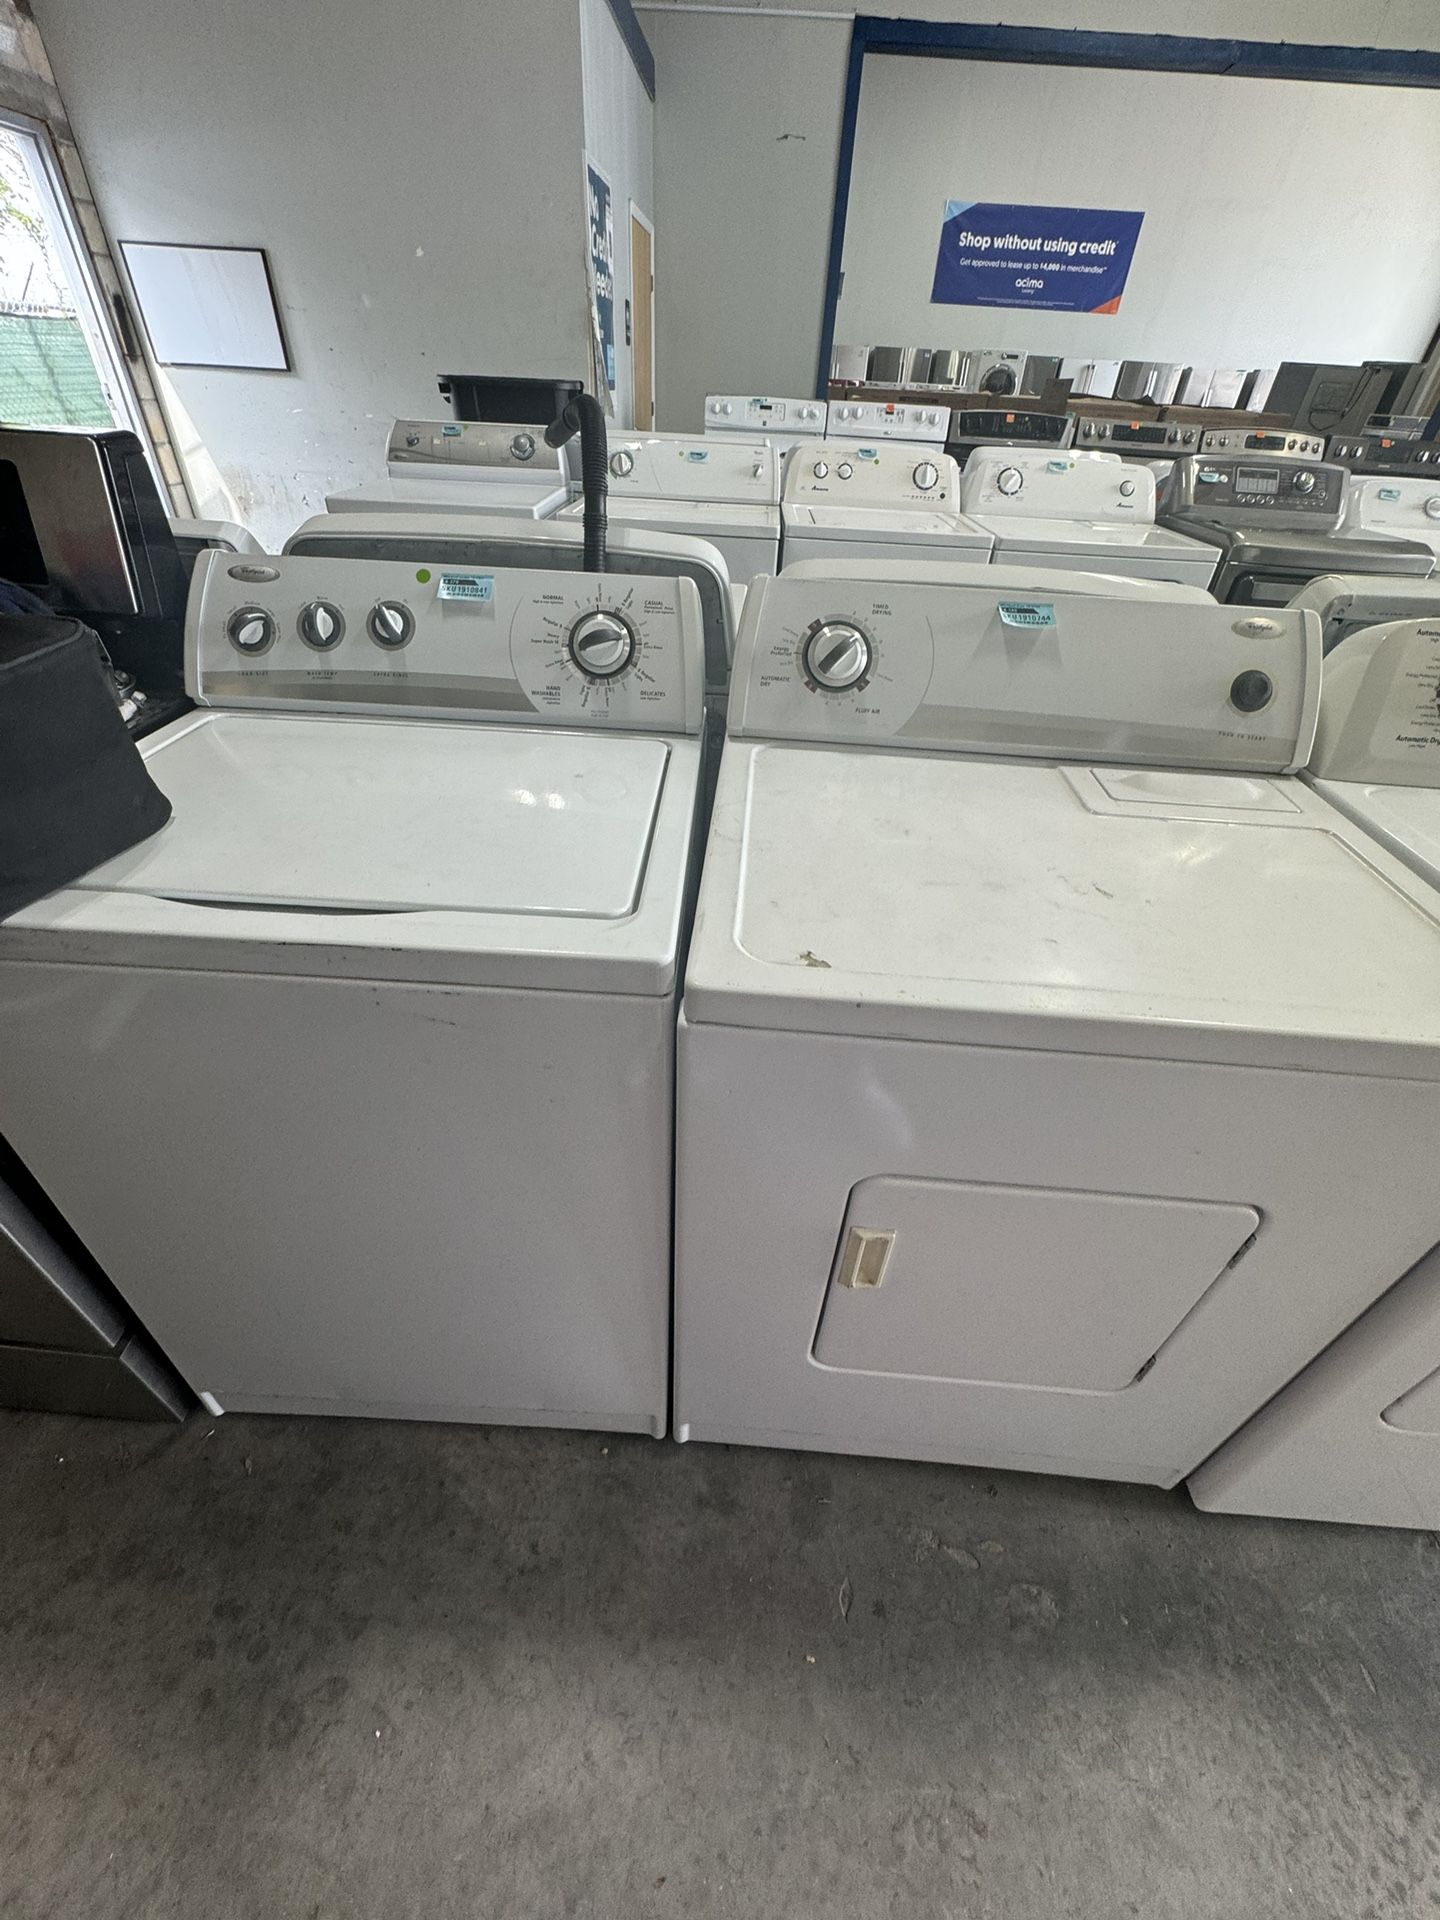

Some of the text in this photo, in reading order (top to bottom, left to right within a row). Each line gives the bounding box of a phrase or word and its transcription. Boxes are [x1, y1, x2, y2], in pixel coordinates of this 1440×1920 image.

[959, 231, 991, 251] Shop
[993, 233, 1042, 251] without
[1043, 237, 1078, 256] using
[960, 257, 971, 266] Get
[971, 259, 1000, 268] approved
[1001, 260, 1007, 268] to
[1008, 261, 1023, 269] lease
[1023, 262, 1032, 270] up
[1032, 262, 1039, 270] to
[1015, 277, 1044, 289] acima
[1395, 734, 1429, 743] Automatic
